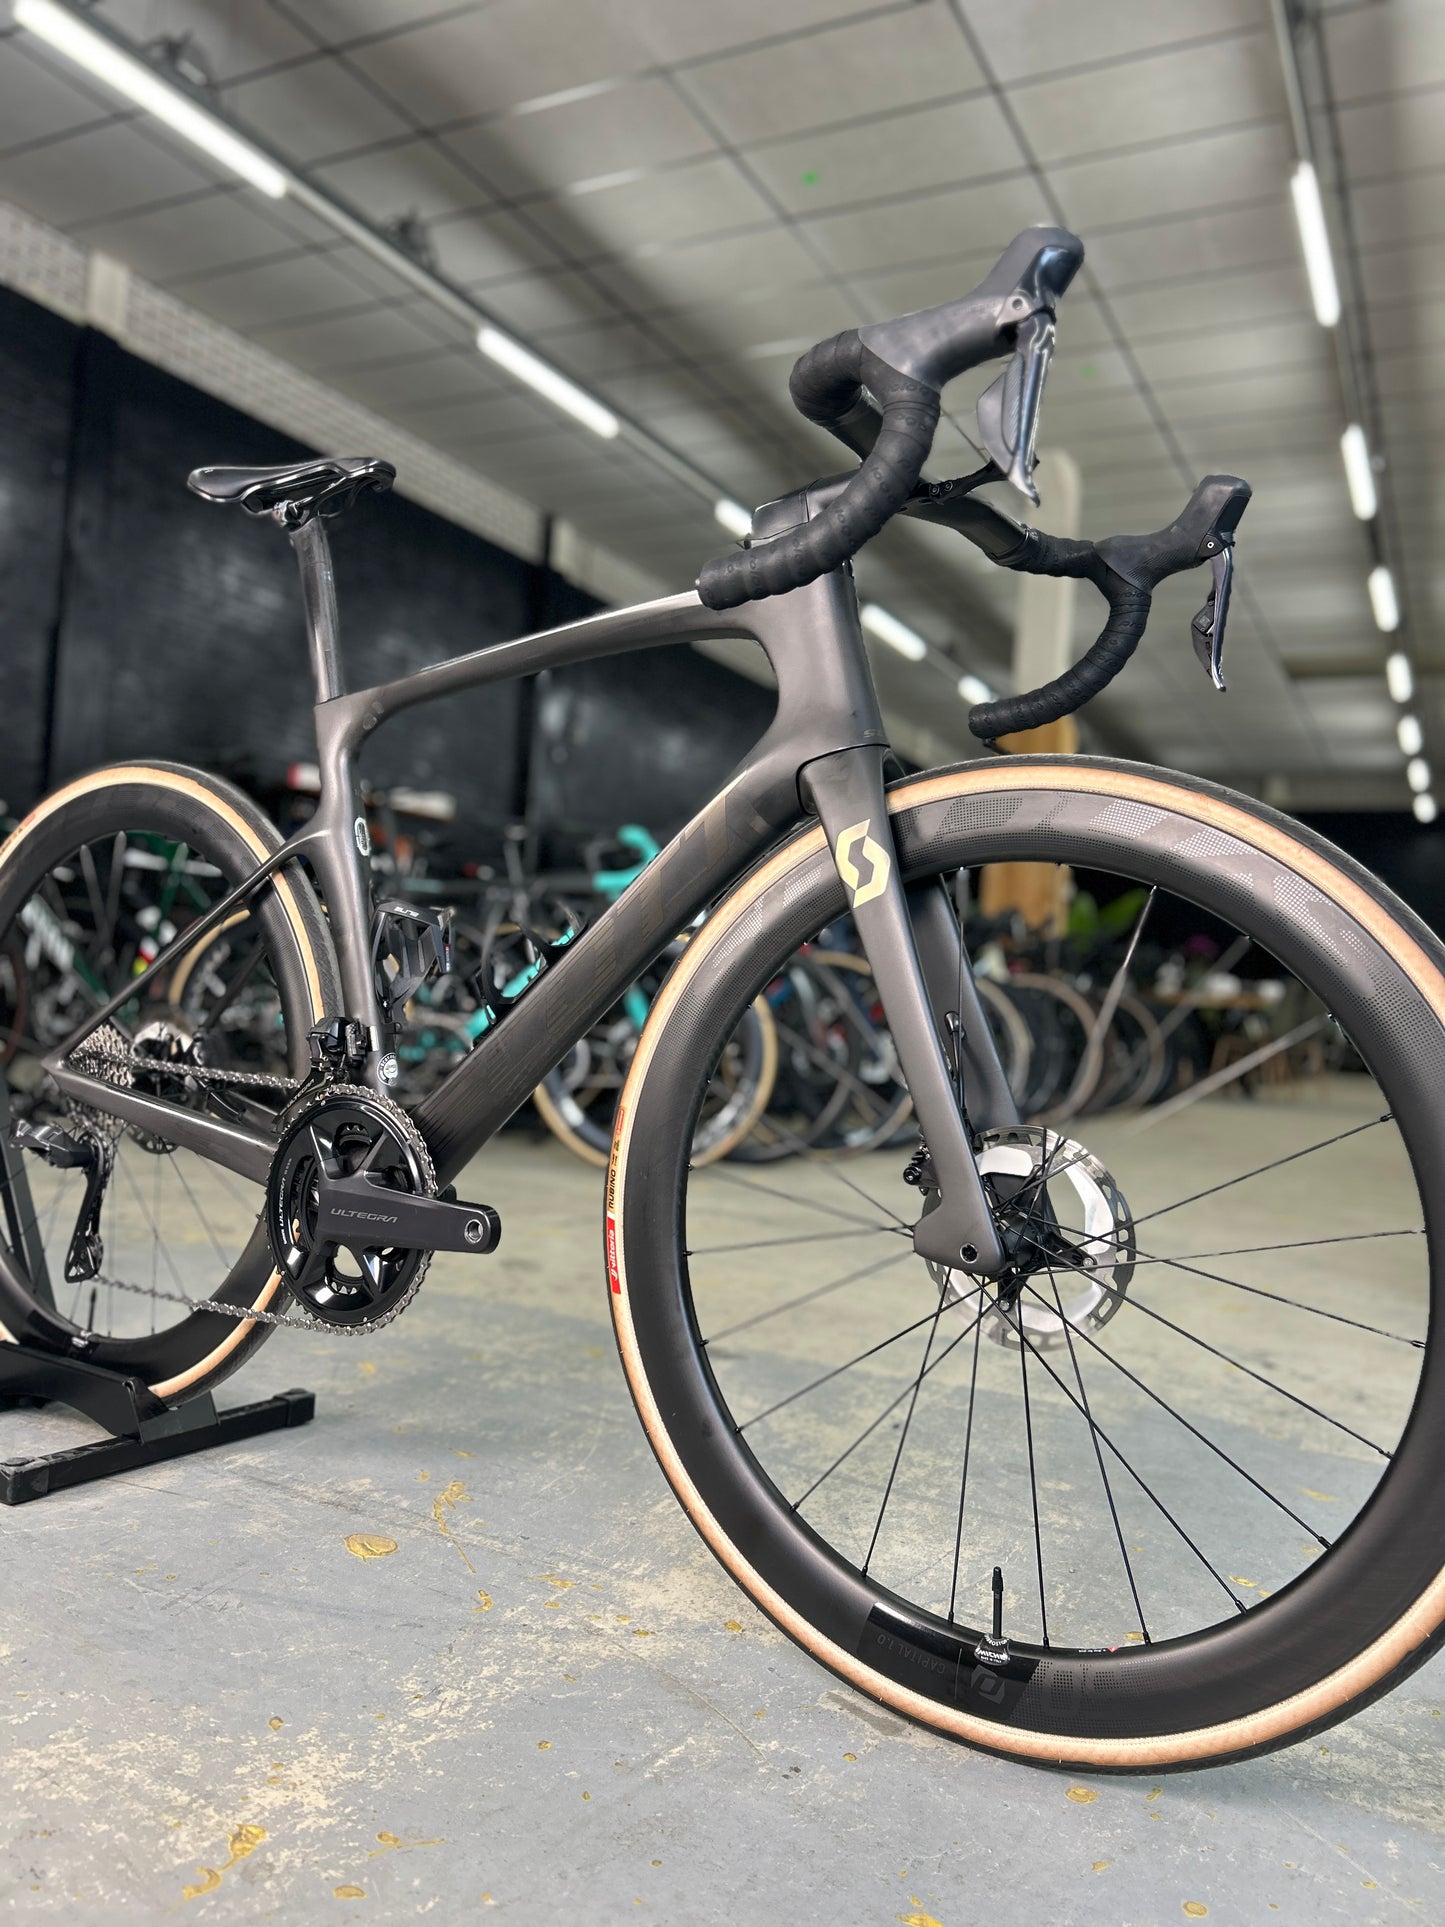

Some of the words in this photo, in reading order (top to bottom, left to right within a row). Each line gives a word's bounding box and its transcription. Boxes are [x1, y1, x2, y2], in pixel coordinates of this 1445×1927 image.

[279, 1177, 287, 1227] ULTEGRA
[608, 1169, 616, 1209] RUBINO
[330, 1208, 398, 1224] ULTEGRA
[608, 1229, 616, 1268] vittoria
[877, 1633, 896, 1650] 1.0
[898, 1645, 946, 1674] CAPITAL
